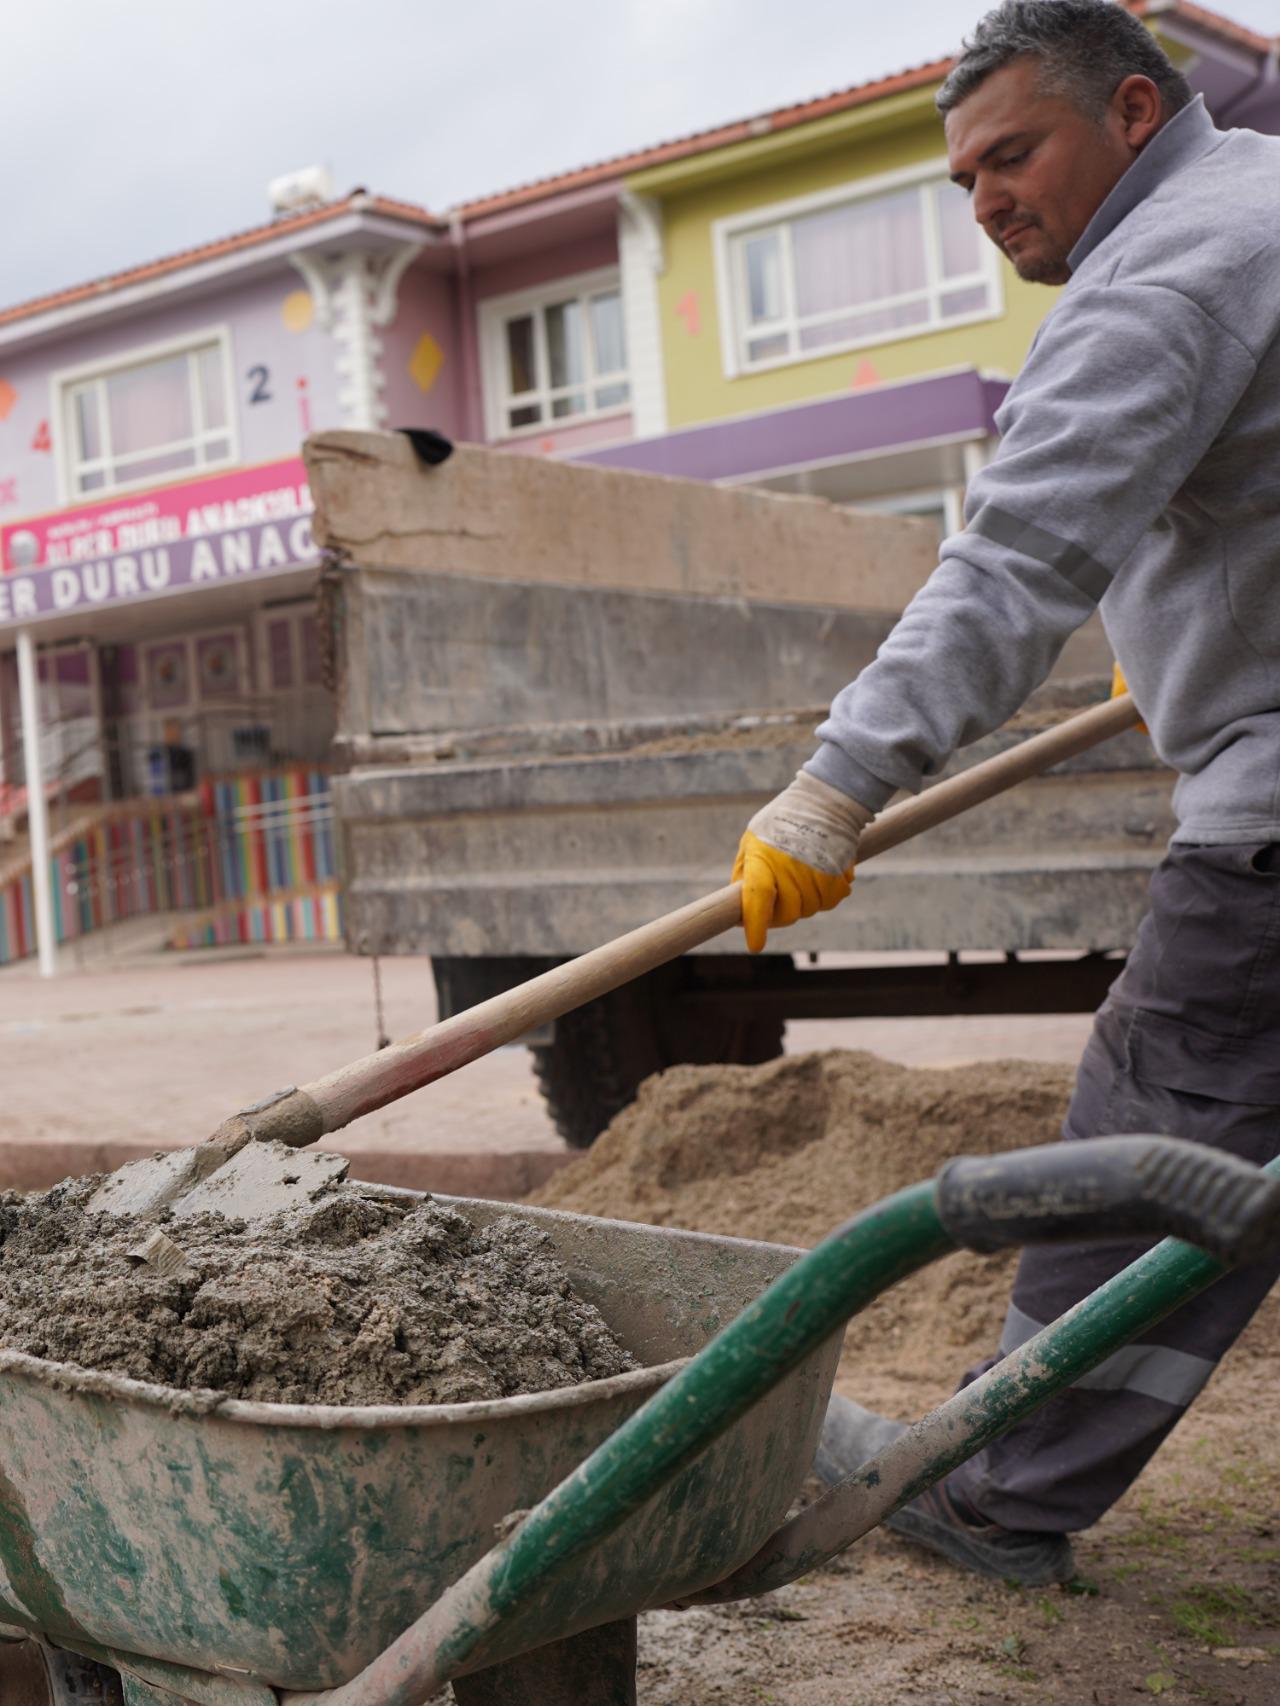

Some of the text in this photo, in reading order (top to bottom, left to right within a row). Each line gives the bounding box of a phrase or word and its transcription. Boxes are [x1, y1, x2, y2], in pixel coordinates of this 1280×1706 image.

[246, 364, 272, 405] 2
[30, 417, 53, 453] 4
[50, 548, 170, 610] DURU
